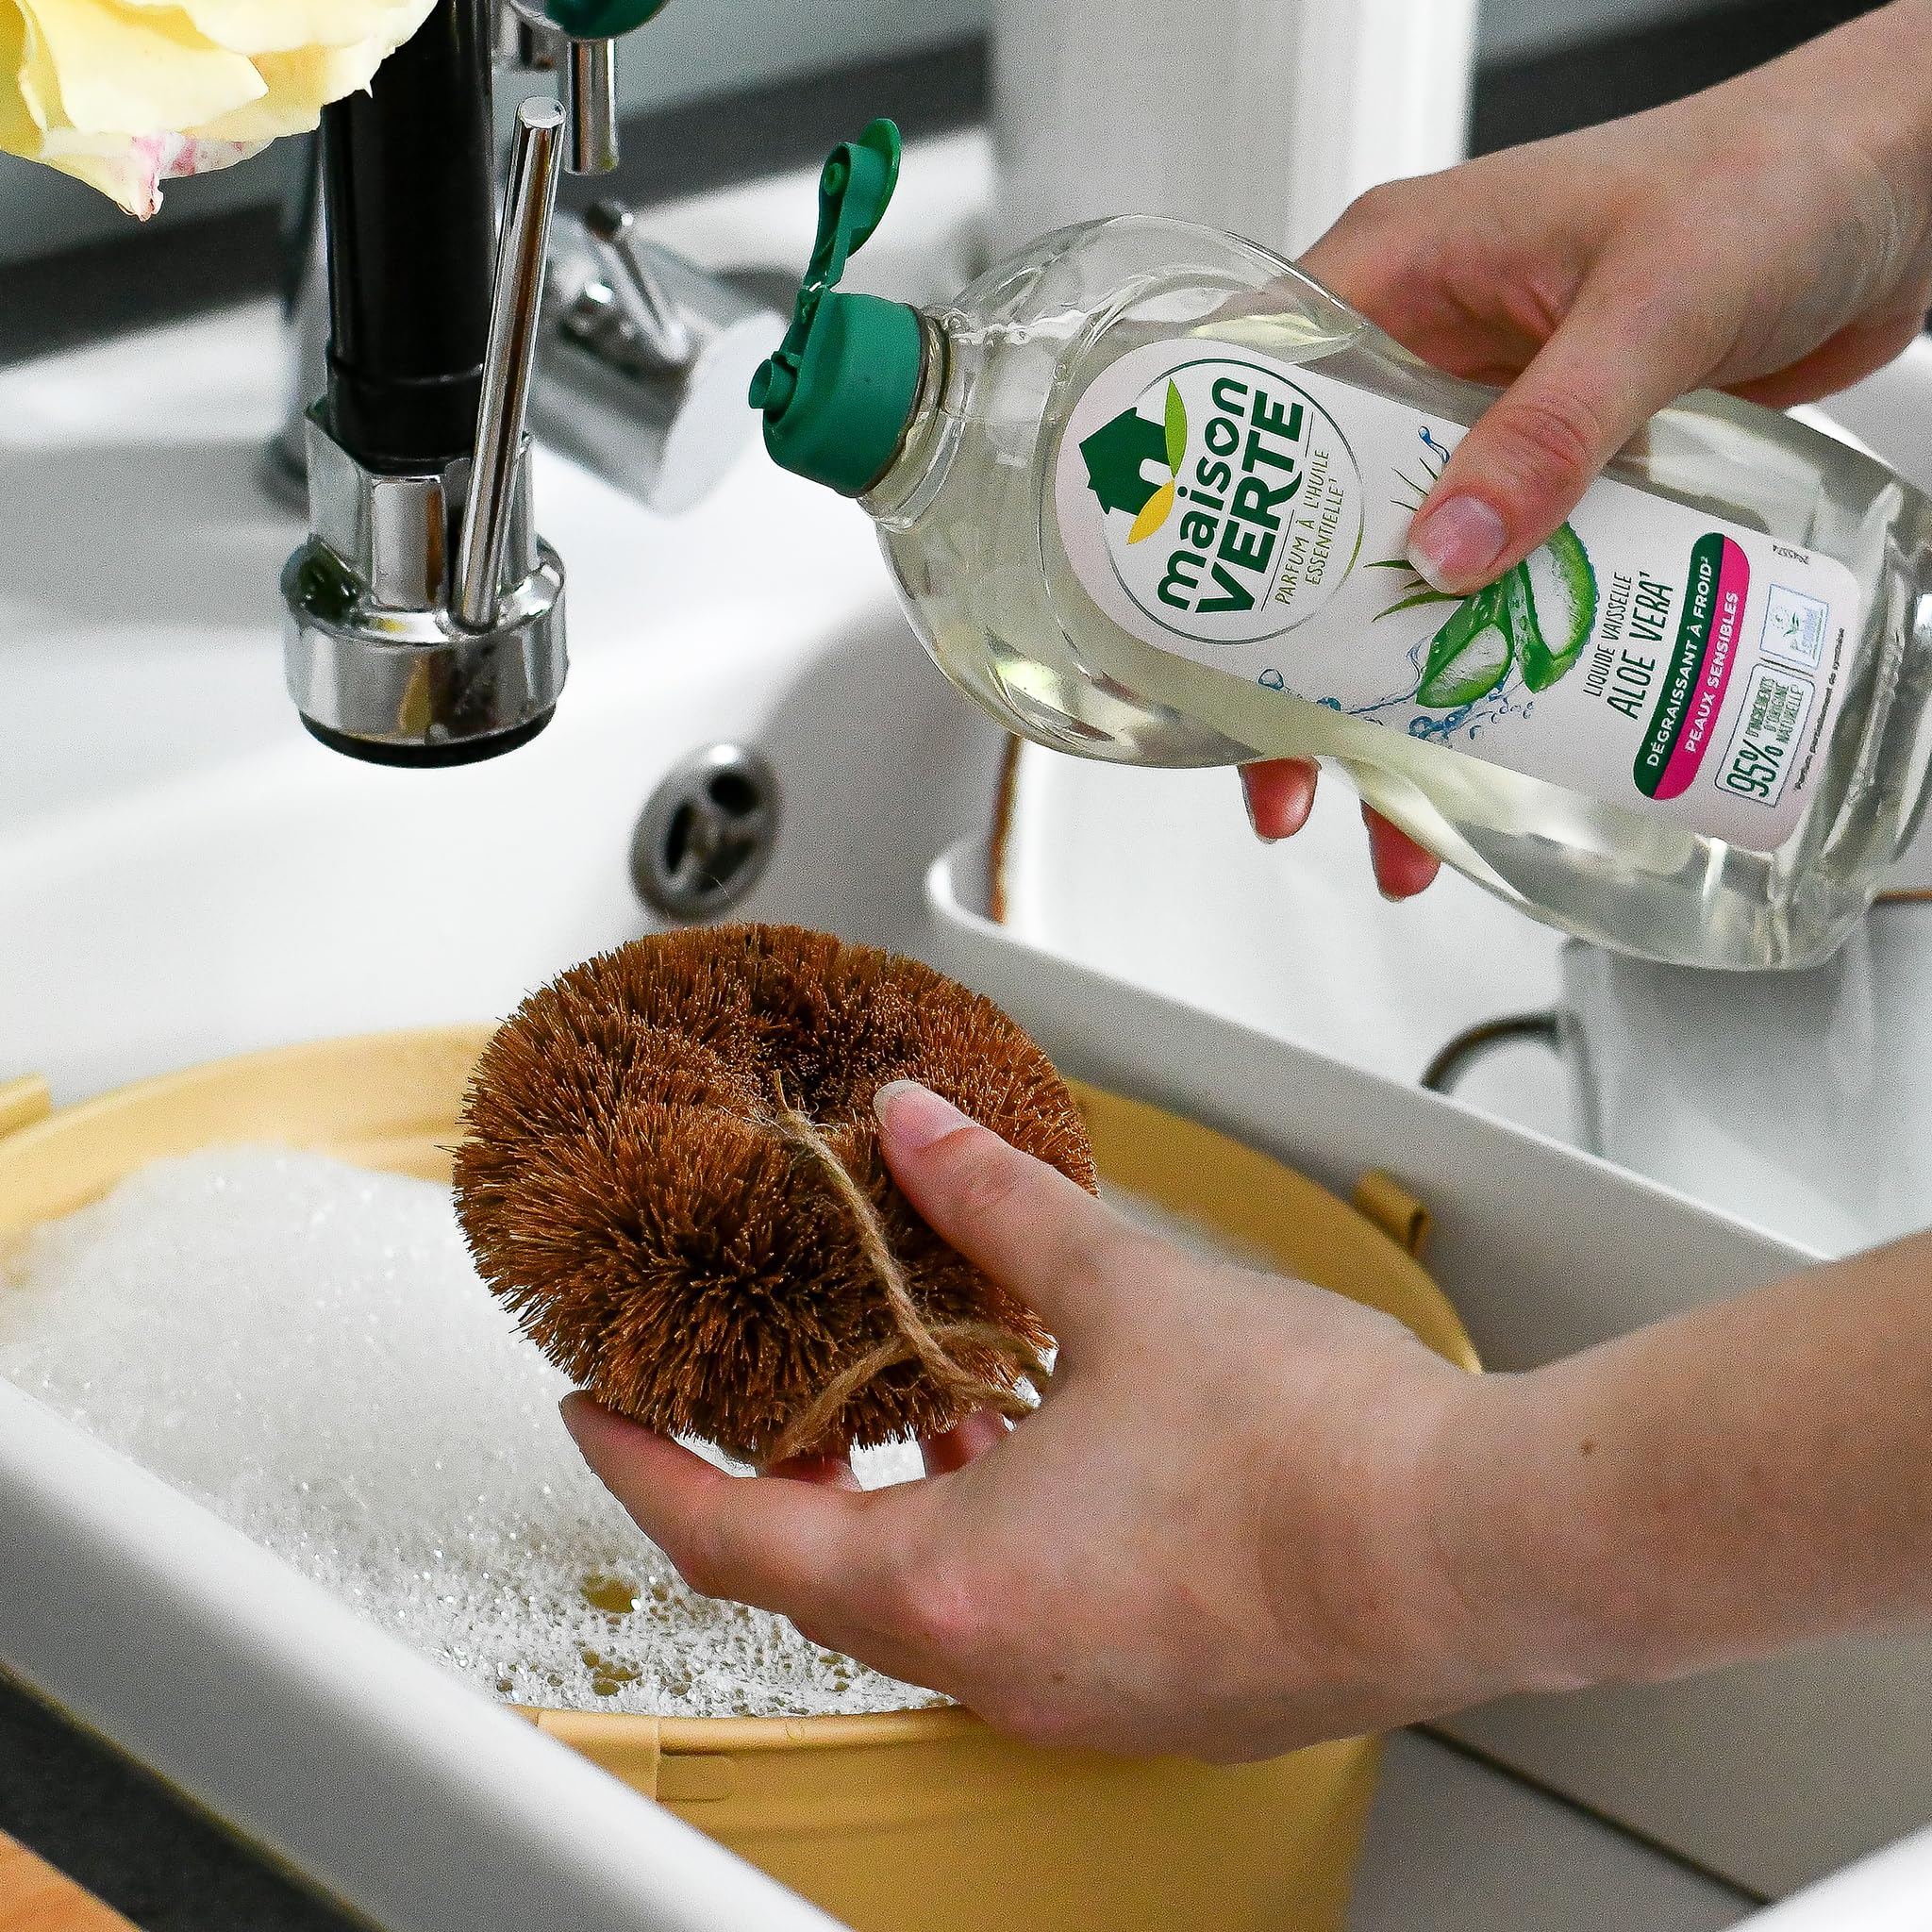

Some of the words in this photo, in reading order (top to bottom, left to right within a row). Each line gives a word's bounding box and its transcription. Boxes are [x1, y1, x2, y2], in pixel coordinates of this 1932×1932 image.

[1157, 377, 1248, 611] maison
[1194, 390, 1305, 613] VERTE
[1295, 519, 1315, 529] À
[1303, 449, 1329, 508] L'HUILE
[1274, 535, 1309, 605] PARFUM
[1583, 643, 1615, 697] LIQUIDE
[1601, 572, 1632, 641] VAISSELLE
[1684, 691, 1716, 752] PEAUX
[1707, 591, 1740, 689] SENSIBLES
[1607, 649, 1656, 720] ALOE
[1646, 639, 1698, 767] DÉGRAISSANT
[1687, 624, 1703, 638] À
[1726, 739, 1784, 797] 95%
